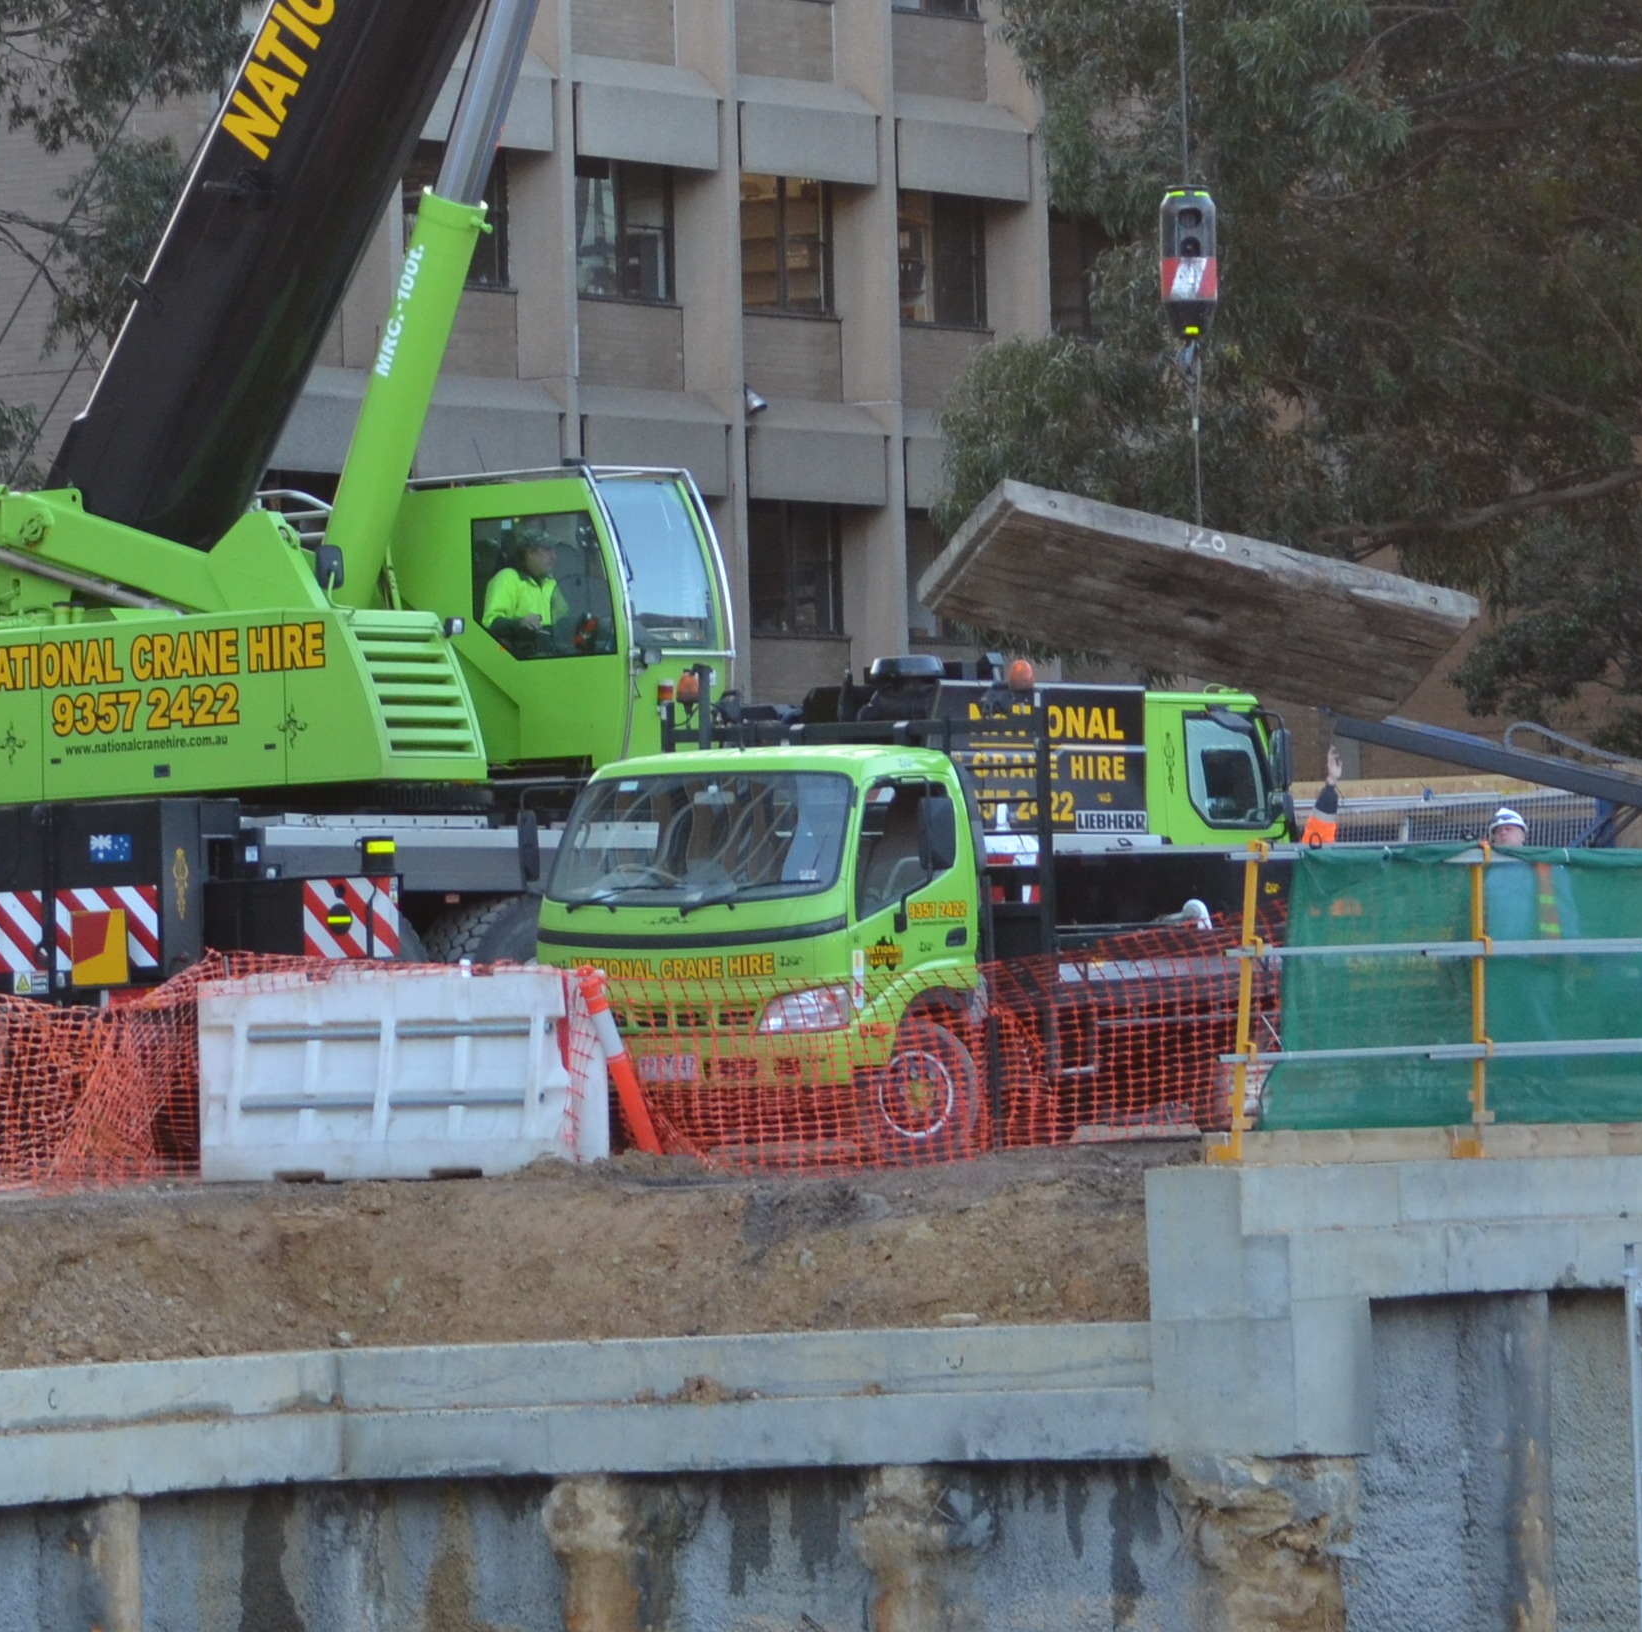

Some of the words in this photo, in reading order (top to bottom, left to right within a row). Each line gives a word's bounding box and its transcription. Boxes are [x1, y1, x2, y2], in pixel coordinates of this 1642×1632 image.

[130, 628, 240, 682] CRANE
[247, 621, 326, 673] HIRE
[51, 690, 141, 737] 9357
[146, 682, 240, 731] 2422
[64, 734, 229, 757] www.nationalcranehire.com.au
[1070, 754, 1126, 781] HIRE
[1077, 812, 1146, 831] LIEBHERR
[908, 902, 937, 920] 9357
[939, 900, 967, 919] 2422
[660, 956, 724, 980] CRANE
[727, 953, 776, 978] HIRE
